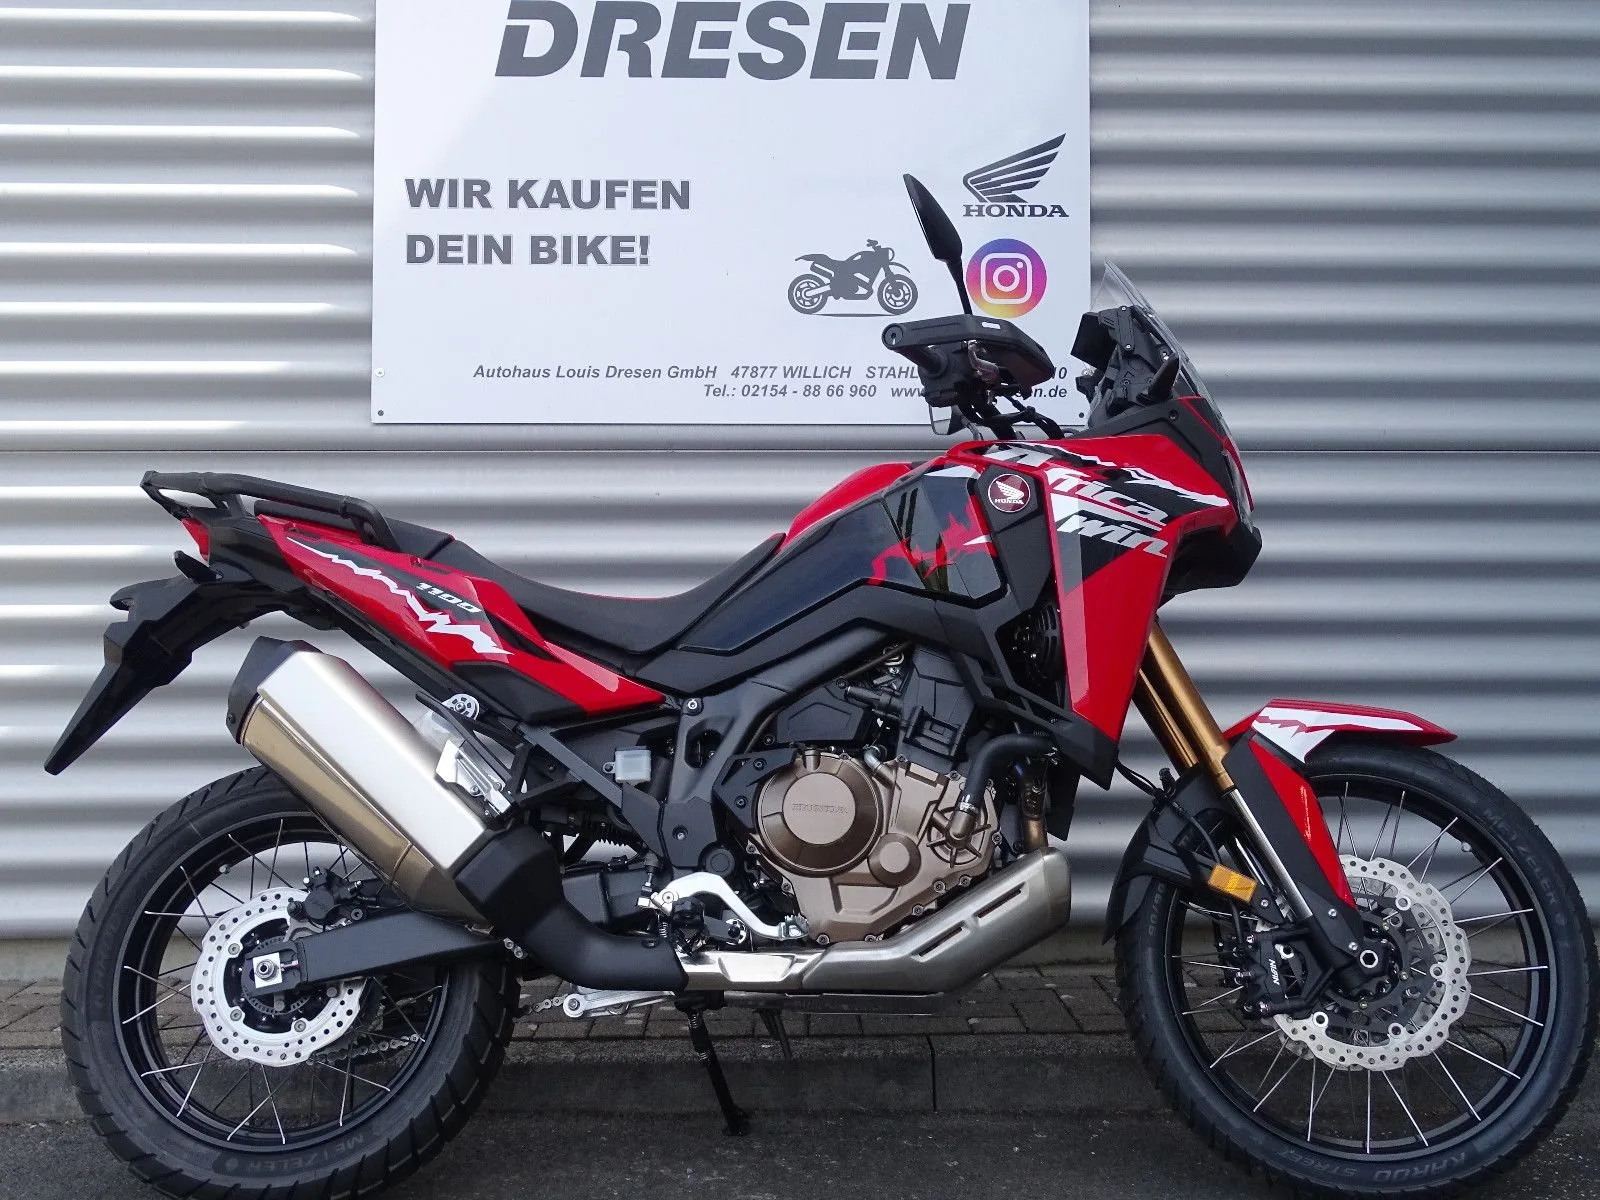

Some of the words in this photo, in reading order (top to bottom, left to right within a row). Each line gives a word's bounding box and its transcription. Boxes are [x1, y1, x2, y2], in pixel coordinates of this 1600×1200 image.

[495, 0, 971, 80] DRESEN
[405, 179, 493, 209] WIR
[508, 179, 690, 209] KAUFEN
[963, 203, 1070, 218] HONDA
[405, 235, 512, 265] DEIN
[529, 235, 650, 266] BIKE!
[473, 365, 551, 379] Autohaus
[556, 365, 600, 379] Louis
[605, 365, 662, 379] Dresen
[667, 365, 717, 379] GmbH
[731, 365, 778, 379] 47877
[782, 365, 852, 379] WILLICH
[866, 365, 919, 379] STAHL
[704, 384, 736, 397] Tel.:
[741, 384, 787, 398] 02154
[802, 384, 822, 398] 88
[826, 384, 845, 398] 66
[849, 384, 877, 398] 960
[994, 497, 1025, 506] HONDA
[416, 582, 482, 613] 1100
